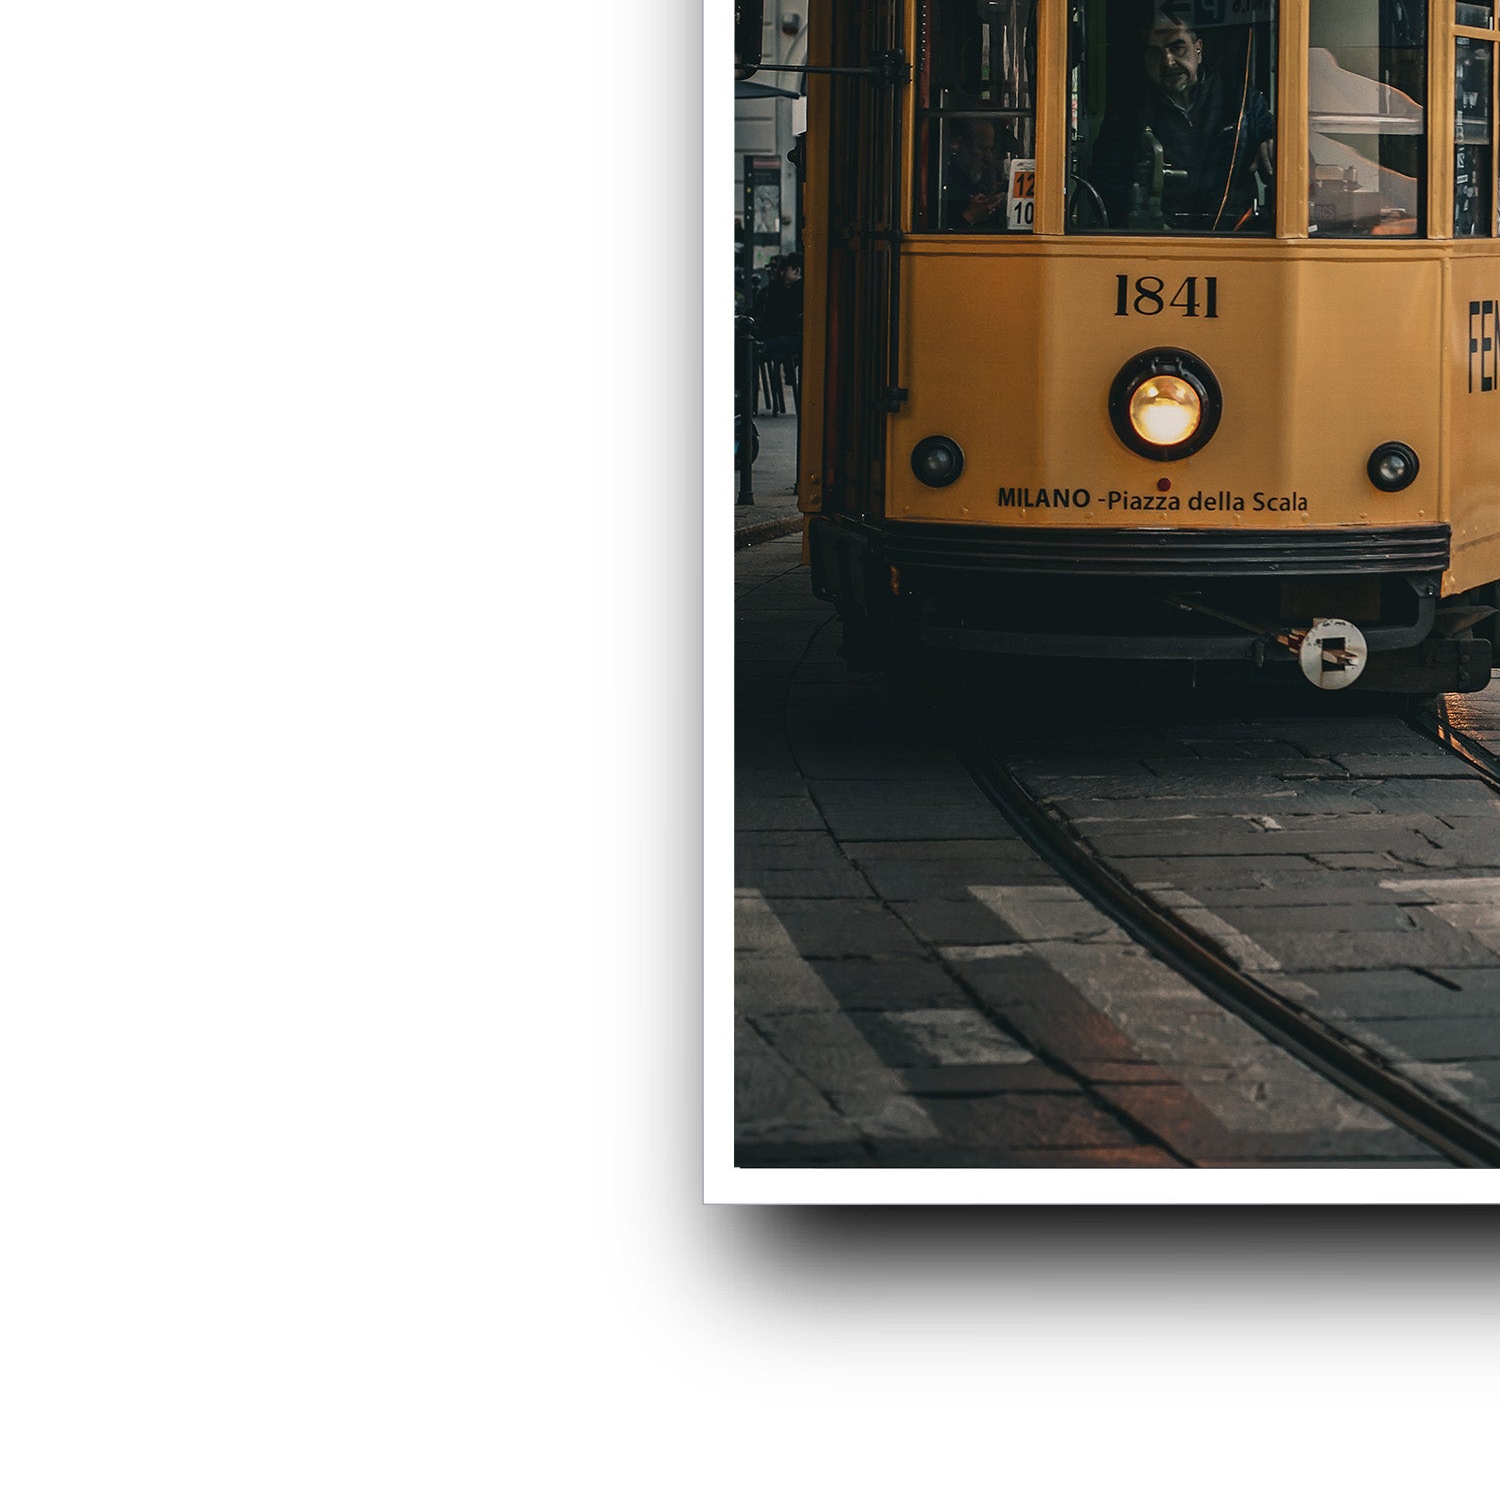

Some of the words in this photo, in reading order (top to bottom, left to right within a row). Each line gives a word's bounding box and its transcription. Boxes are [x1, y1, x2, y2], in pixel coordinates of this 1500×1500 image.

[1016, 173, 1036, 197] 12
[1014, 201, 1034, 225] 10
[1115, 274, 1219, 319] 1841
[997, 486, 1091, 509] MILANO
[1188, 489, 1246, 512] della
[1252, 491, 1309, 513] Scala
